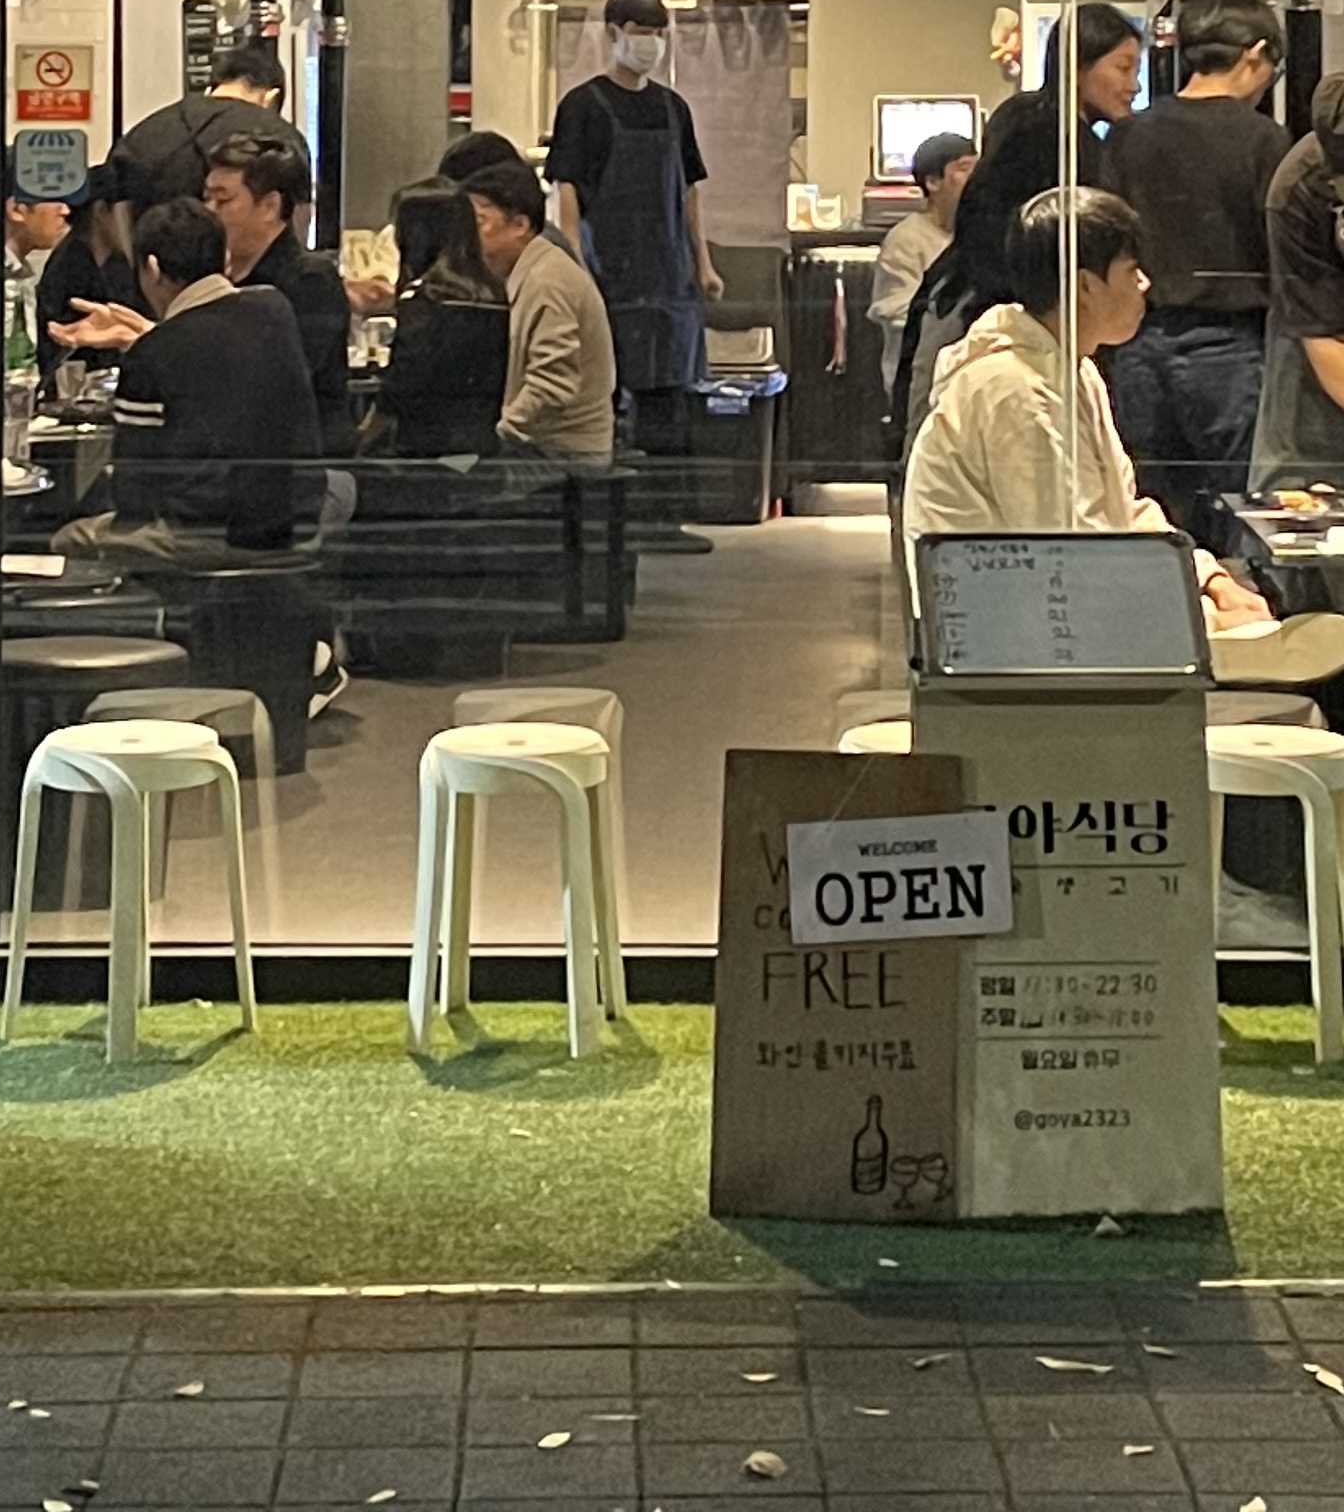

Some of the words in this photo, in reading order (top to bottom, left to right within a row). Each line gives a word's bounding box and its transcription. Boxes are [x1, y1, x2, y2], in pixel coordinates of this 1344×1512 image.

[858, 839, 938, 857] WELCOME
[963, 800, 1175, 855] 야식당
[815, 864, 985, 926] OPEN
[763, 949, 905, 1010] FREE
[1021, 1048, 1077, 1070] 월요일
